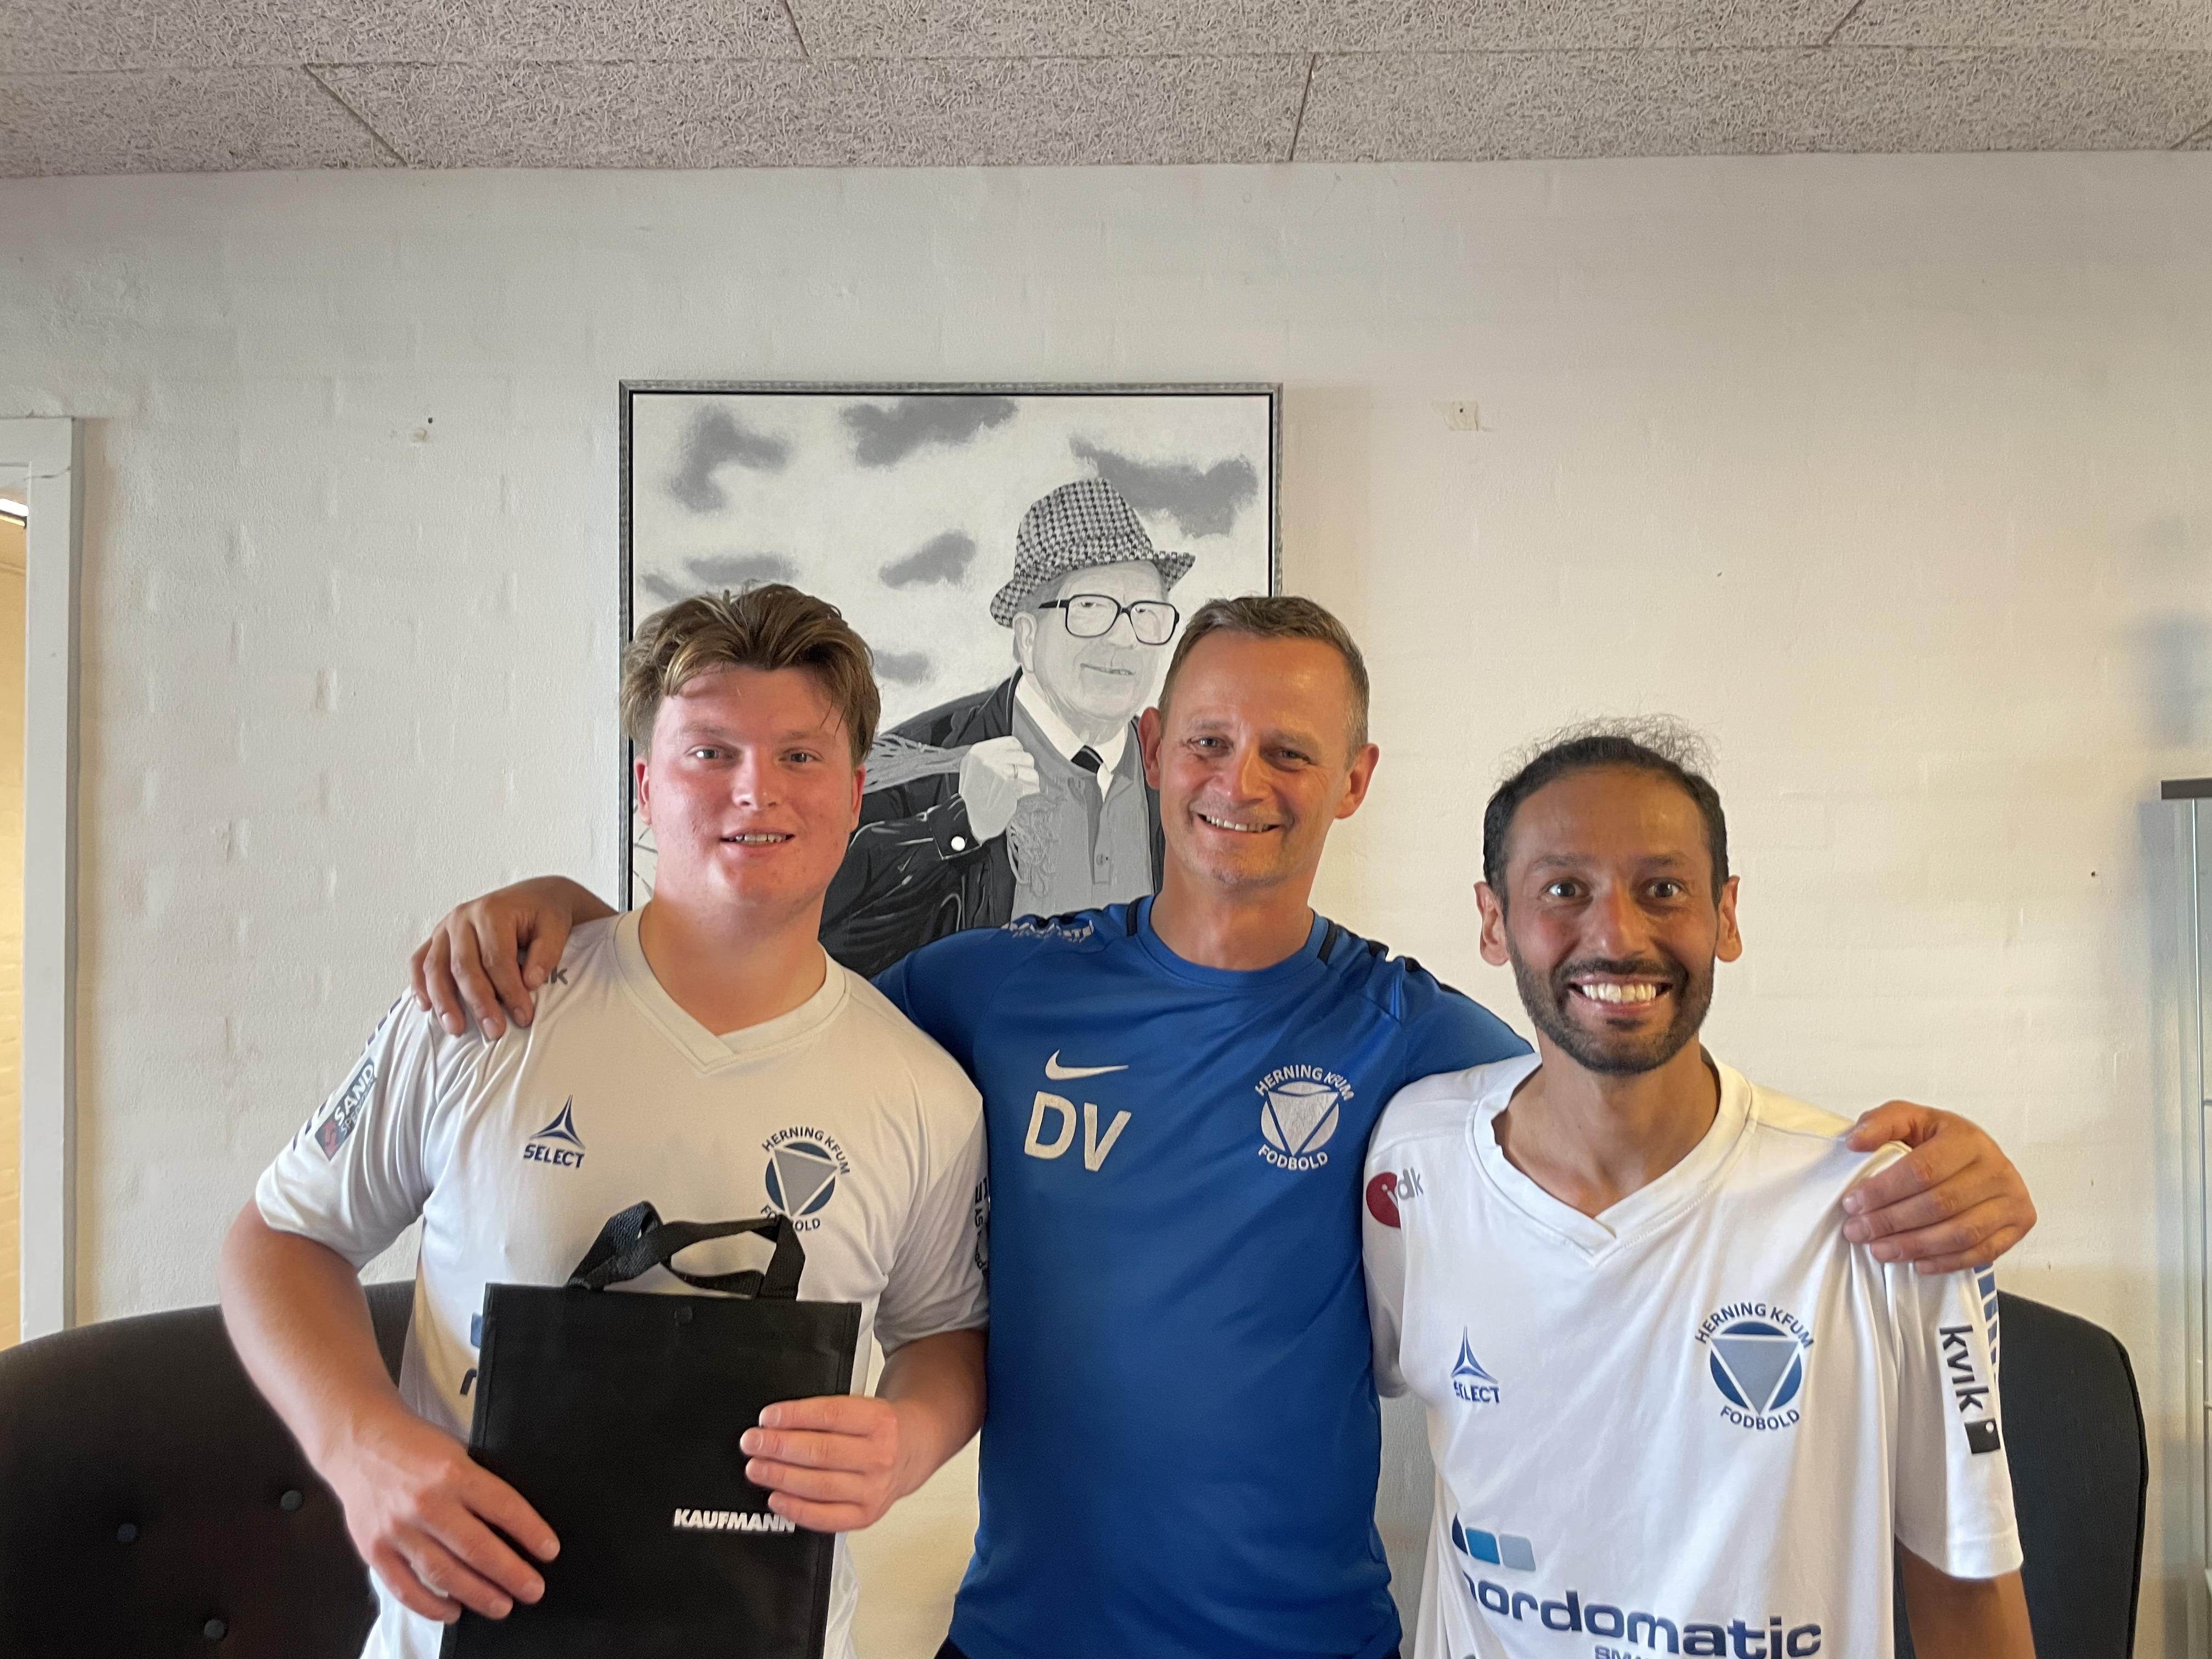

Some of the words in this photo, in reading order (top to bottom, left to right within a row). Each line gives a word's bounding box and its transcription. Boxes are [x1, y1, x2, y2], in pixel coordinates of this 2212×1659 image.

[334, 1063, 376, 1126] SAND
[1255, 1064, 1323, 1098] HERNING
[1323, 1071, 1355, 1101] KFUM
[1024, 1090, 1132, 1172] DV
[523, 1143, 585, 1170] SELECT
[761, 1126, 824, 1153] HERNING
[825, 1136, 850, 1175] KFUM
[1257, 1143, 1329, 1171] FODBOLD
[760, 1204, 821, 1233] FOOLD
[1695, 1302, 1767, 1345] HERNING
[1769, 1307, 1814, 1350] KFUM
[1719, 1405, 1801, 1431] FODBOLD
[673, 1508, 795, 1533] KAUFMANN
